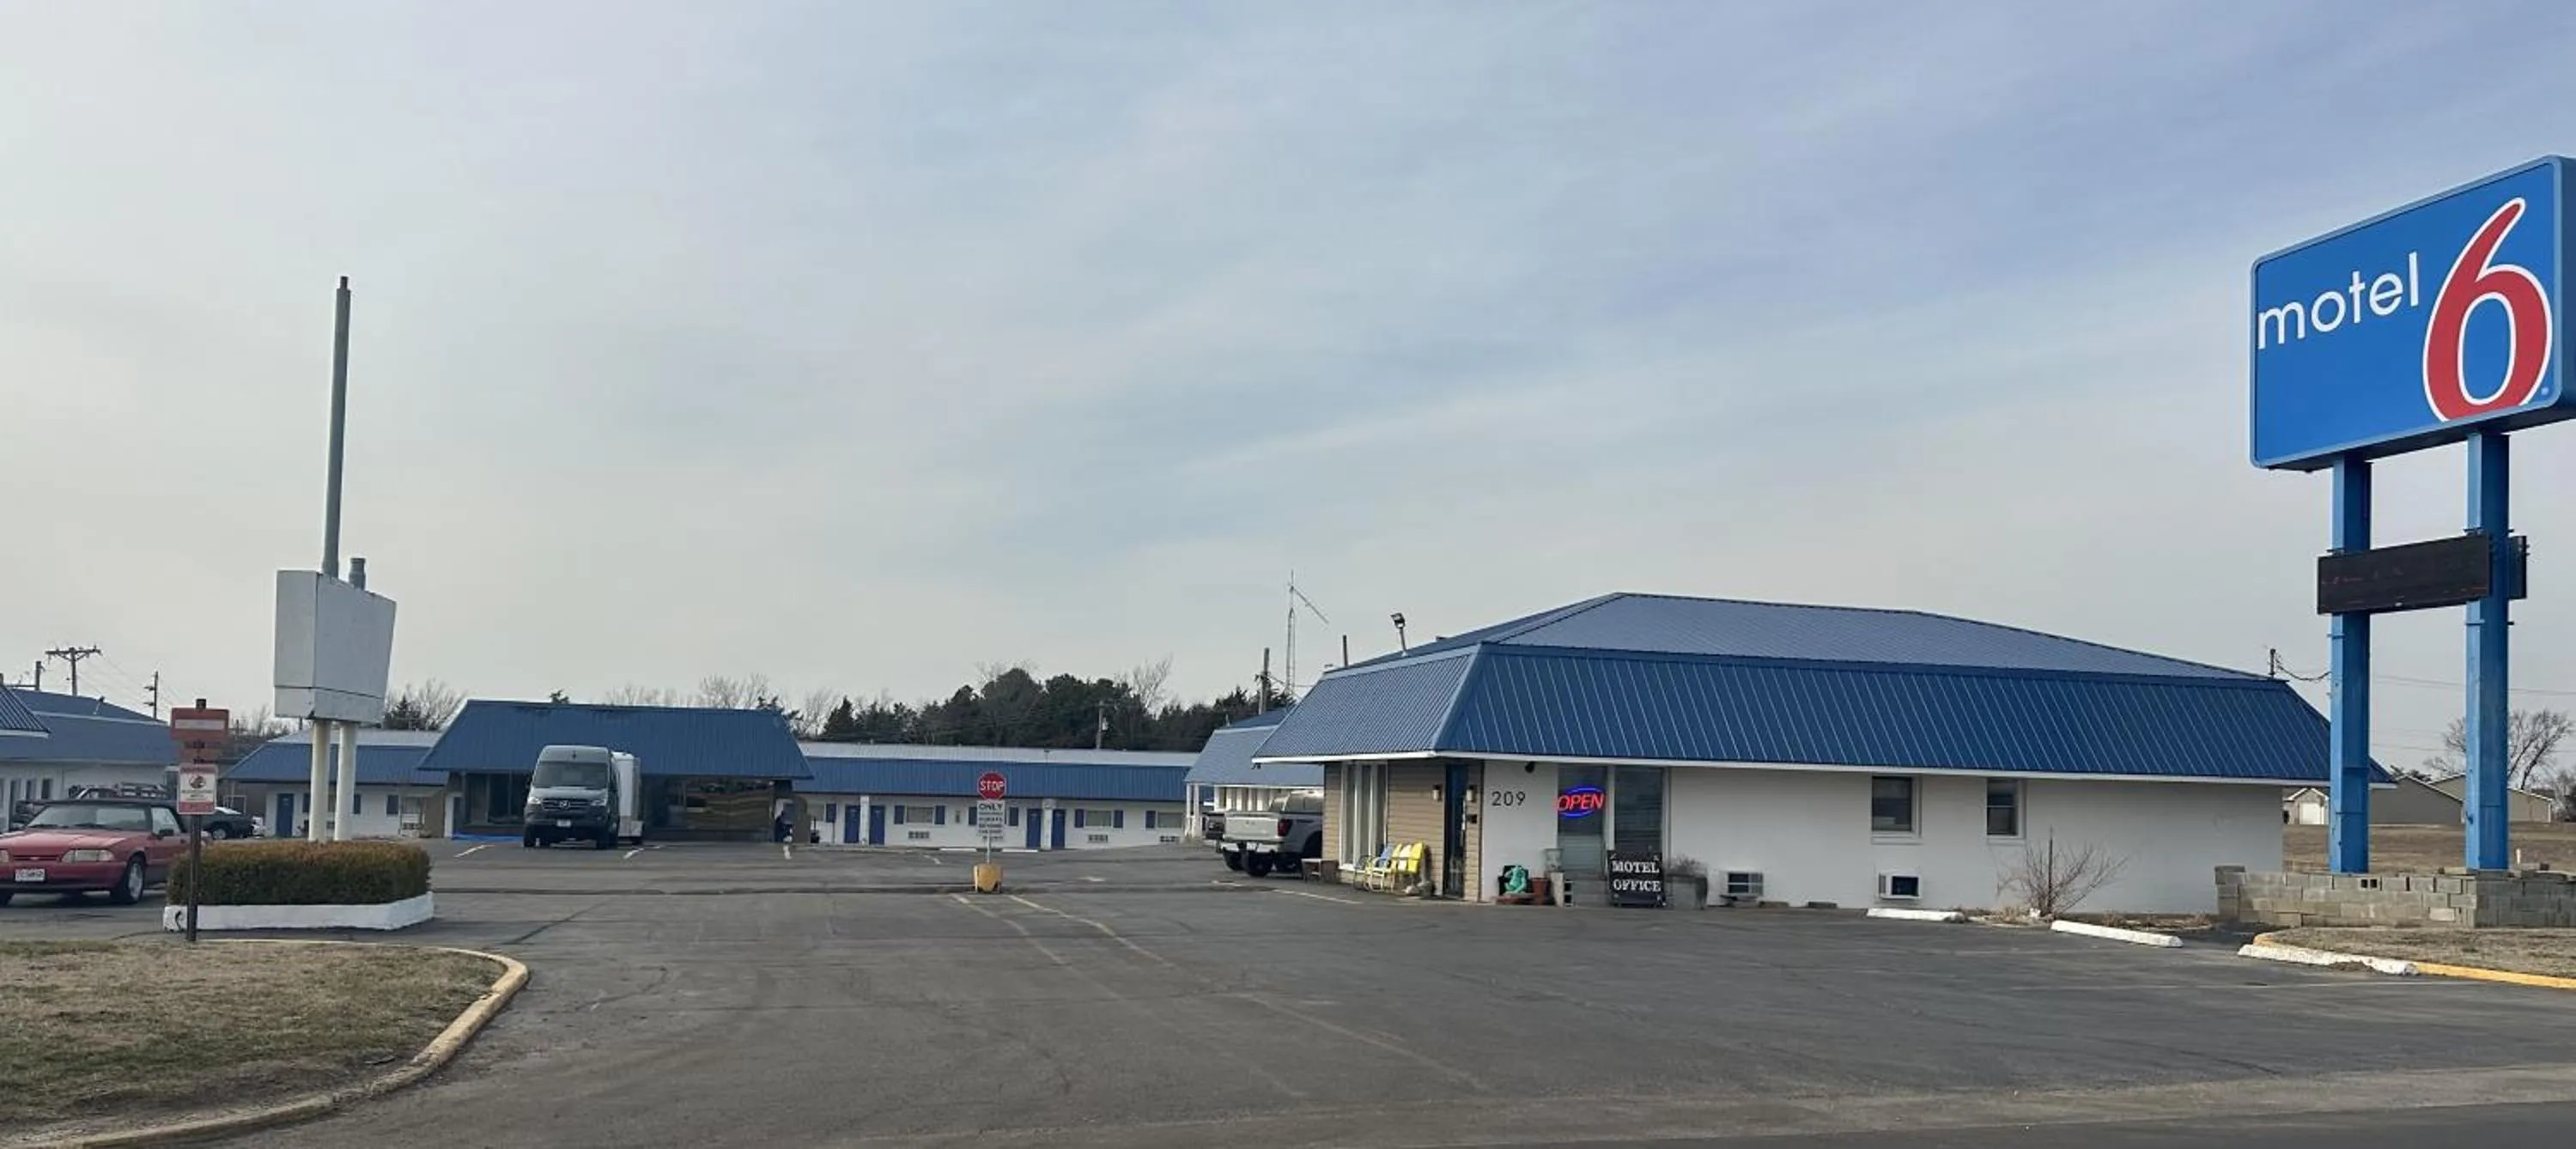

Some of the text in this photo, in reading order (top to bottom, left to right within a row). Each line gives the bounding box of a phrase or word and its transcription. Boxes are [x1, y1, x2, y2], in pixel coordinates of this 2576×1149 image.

[2257, 197, 2554, 423] motel 6
[980, 780, 1005, 791] STOP
[1491, 790, 1527, 806] 209
[1557, 793, 1605, 812] OPEN
[979, 803, 1003, 812] ONLY
[1612, 860, 1660, 873] MOTEL
[1613, 878, 1662, 892] OFFICE
